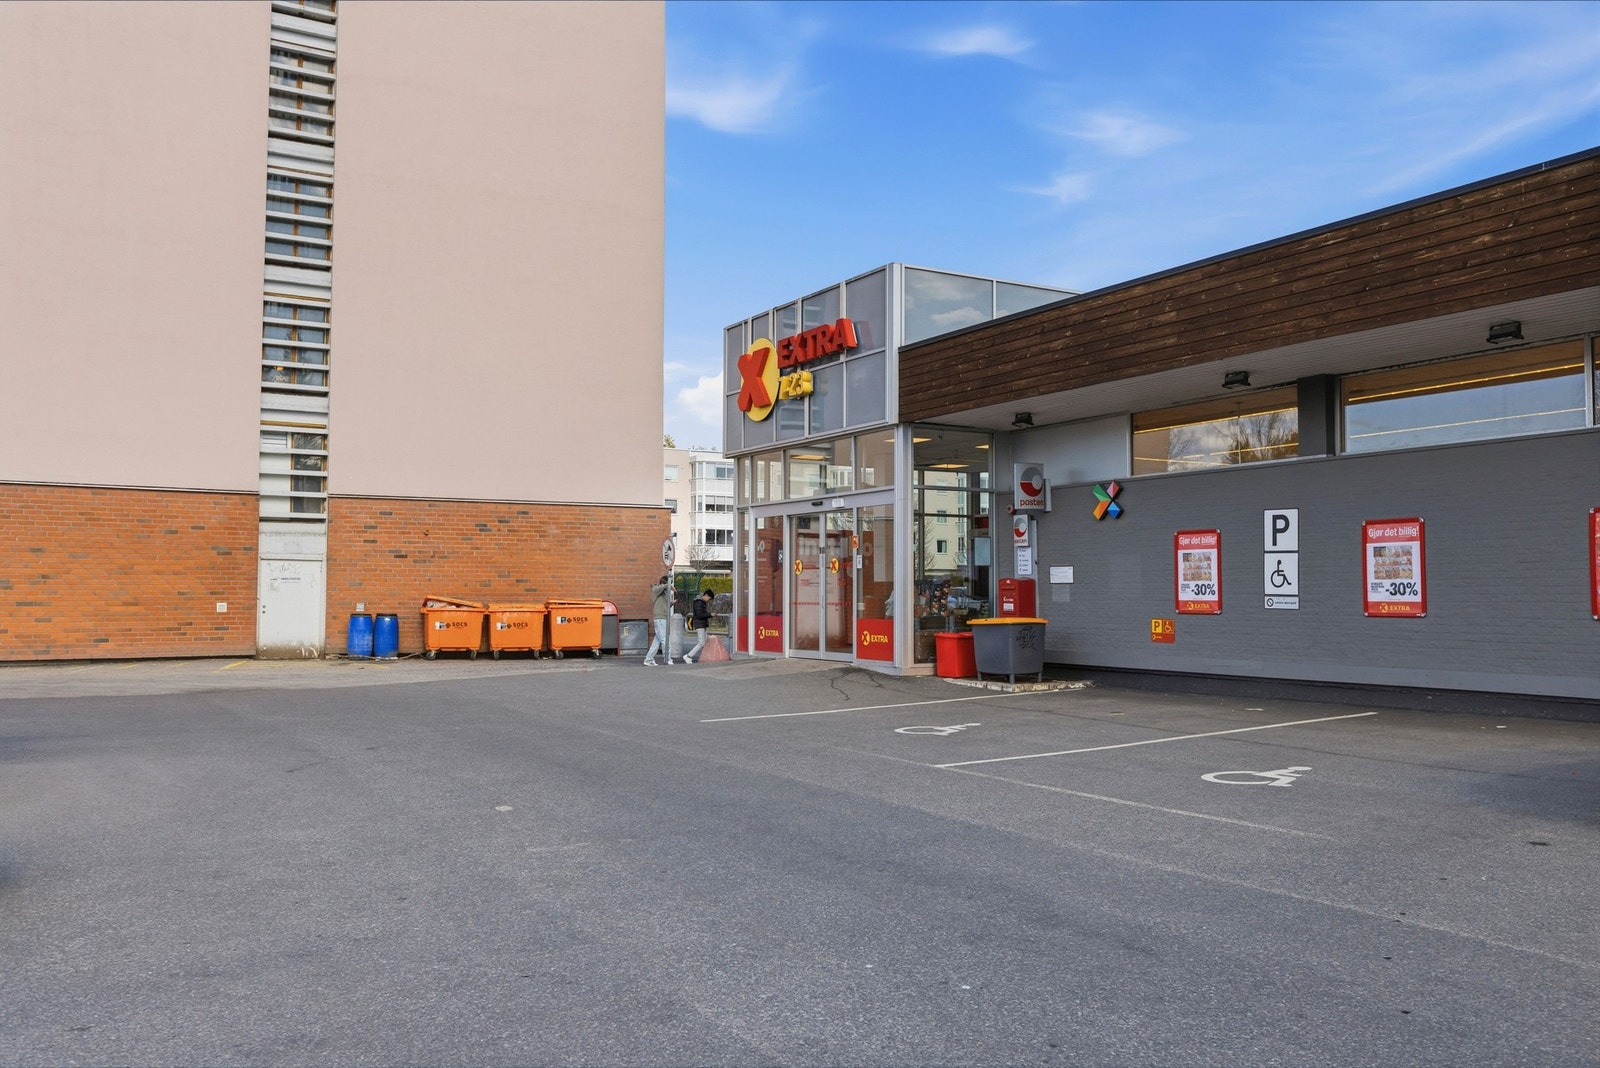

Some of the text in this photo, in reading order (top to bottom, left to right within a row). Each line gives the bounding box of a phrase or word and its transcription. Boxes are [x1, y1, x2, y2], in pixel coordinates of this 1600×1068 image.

[777, 317, 858, 369] EXTRA
[1020, 498, 1045, 507] posten
[1272, 514, 1290, 547] P
[1368, 525, 1420, 539] Gjør det billig!
[1191, 583, 1216, 596] -30%
[1385, 582, 1419, 596] -30%
[1154, 620, 1160, 632] P
[765, 629, 780, 637] EXTRA
[871, 634, 889, 643] EXTRA
